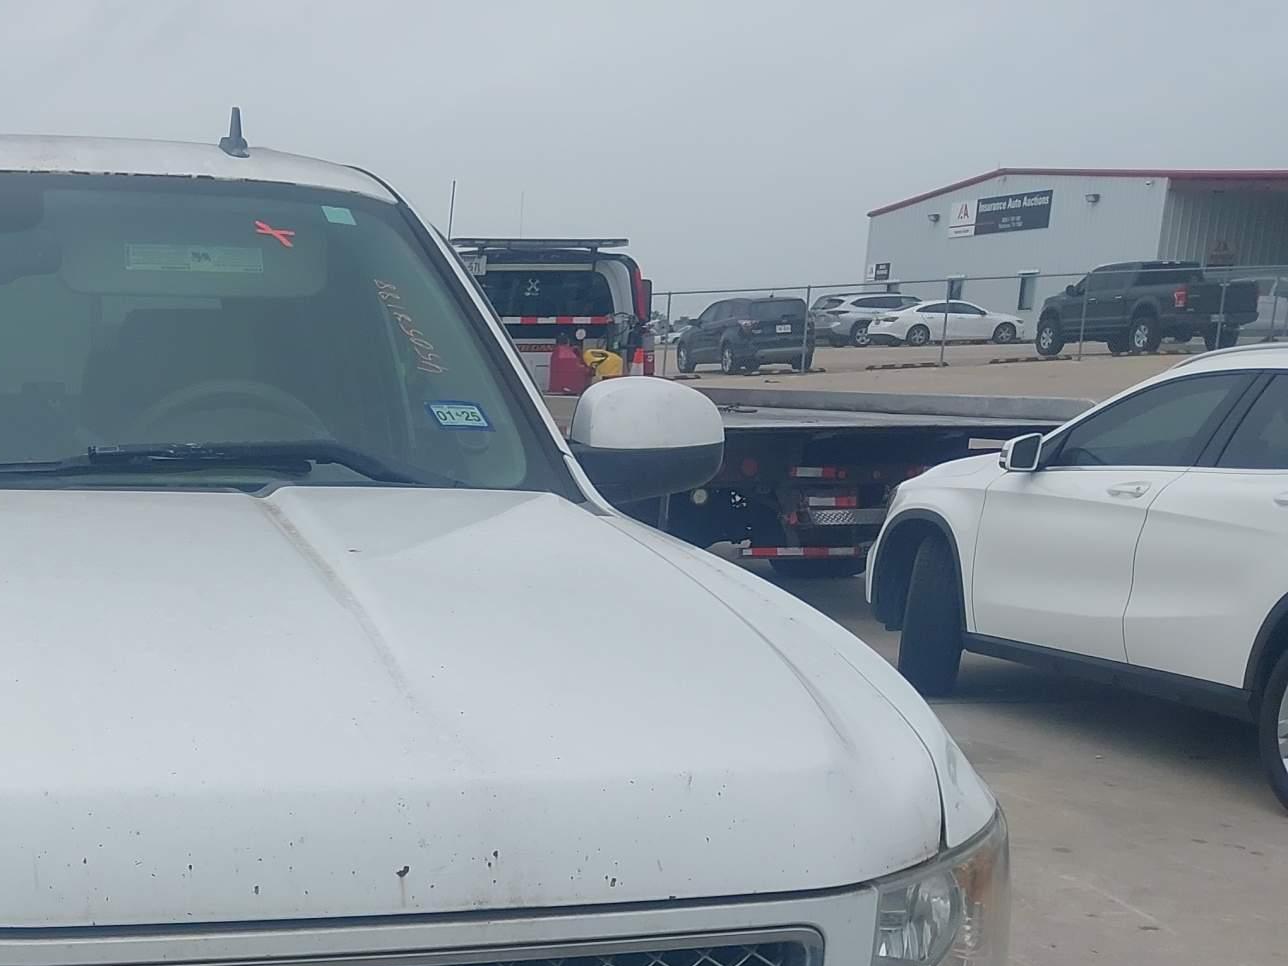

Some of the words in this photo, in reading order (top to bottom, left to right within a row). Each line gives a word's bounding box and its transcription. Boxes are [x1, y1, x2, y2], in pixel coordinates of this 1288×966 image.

[979, 201, 1007, 213] Insurance
[1007, 197, 1022, 209] Auto
[1023, 194, 1050, 207] Auctions
